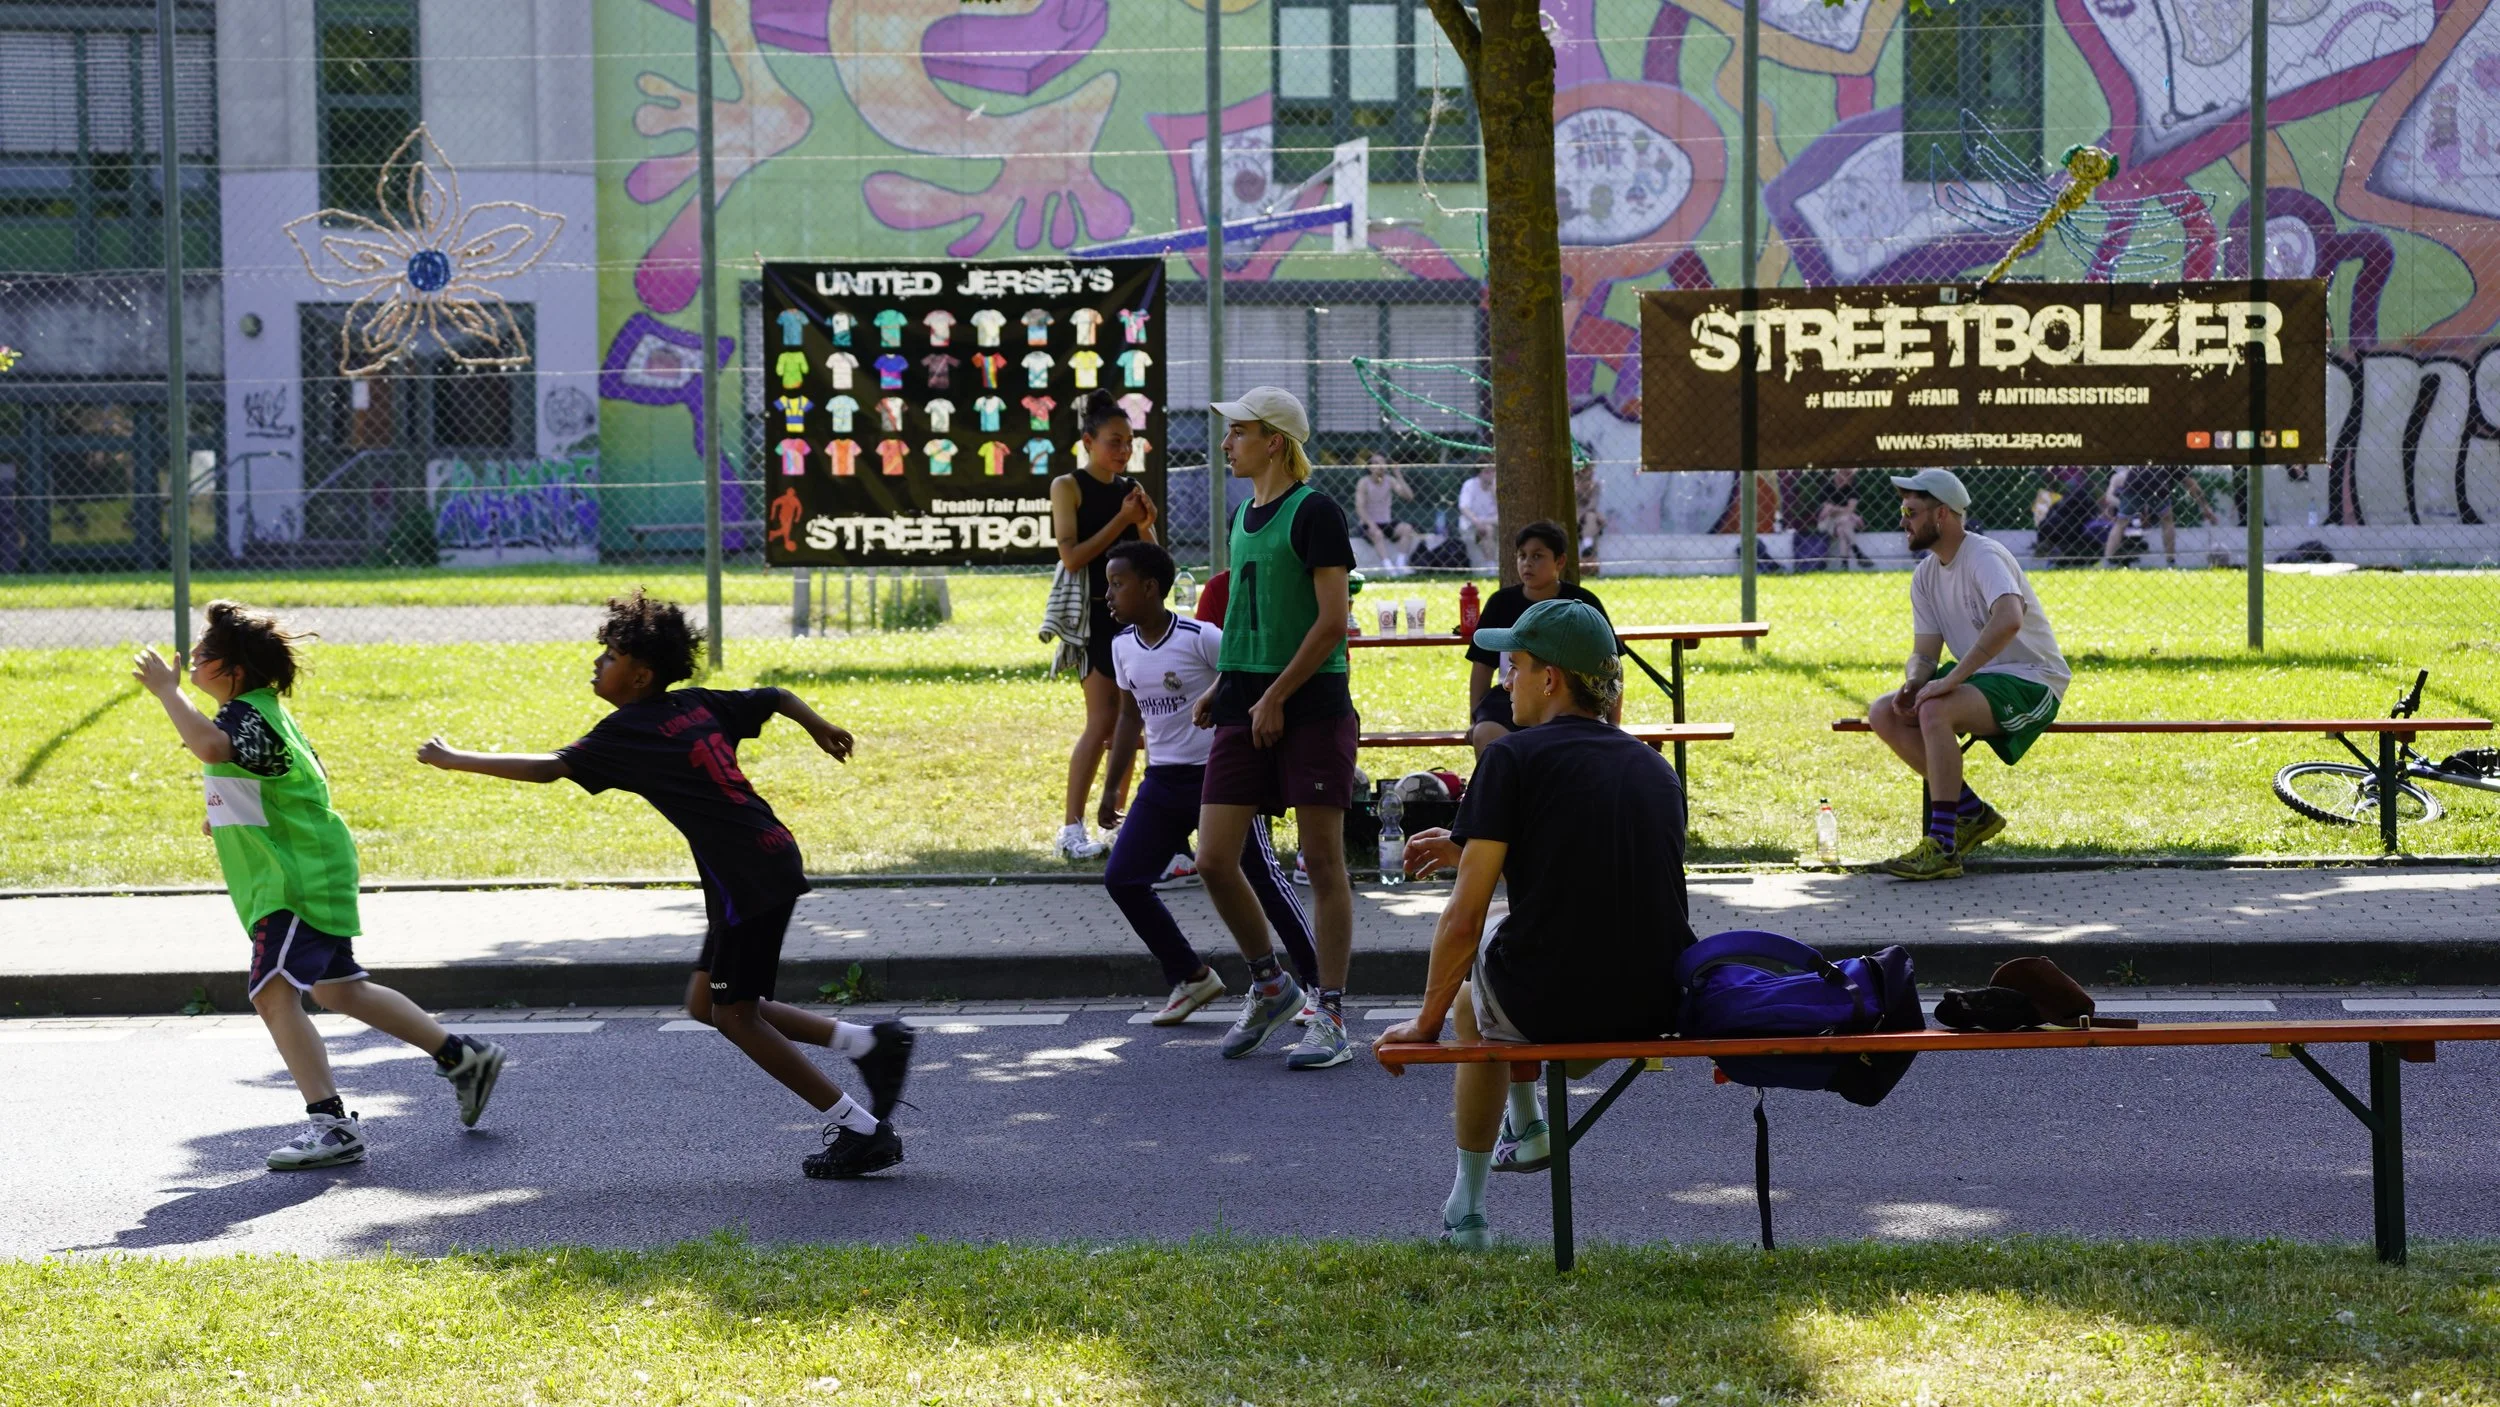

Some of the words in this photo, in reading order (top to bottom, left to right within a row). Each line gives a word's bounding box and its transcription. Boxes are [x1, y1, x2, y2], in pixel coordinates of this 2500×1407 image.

[815, 270, 942, 297] UNITED
[956, 268, 1114, 297] JERSEYS
[1689, 299, 2284, 375] STREETBOLZER
[1908, 388, 1959, 406] #FAIR
[1875, 433, 2083, 451] WWW.STREETBOLZER.COM
[931, 498, 985, 514] Kreativ
[986, 498, 1015, 513] Fair
[1239, 560, 1259, 632] 1
